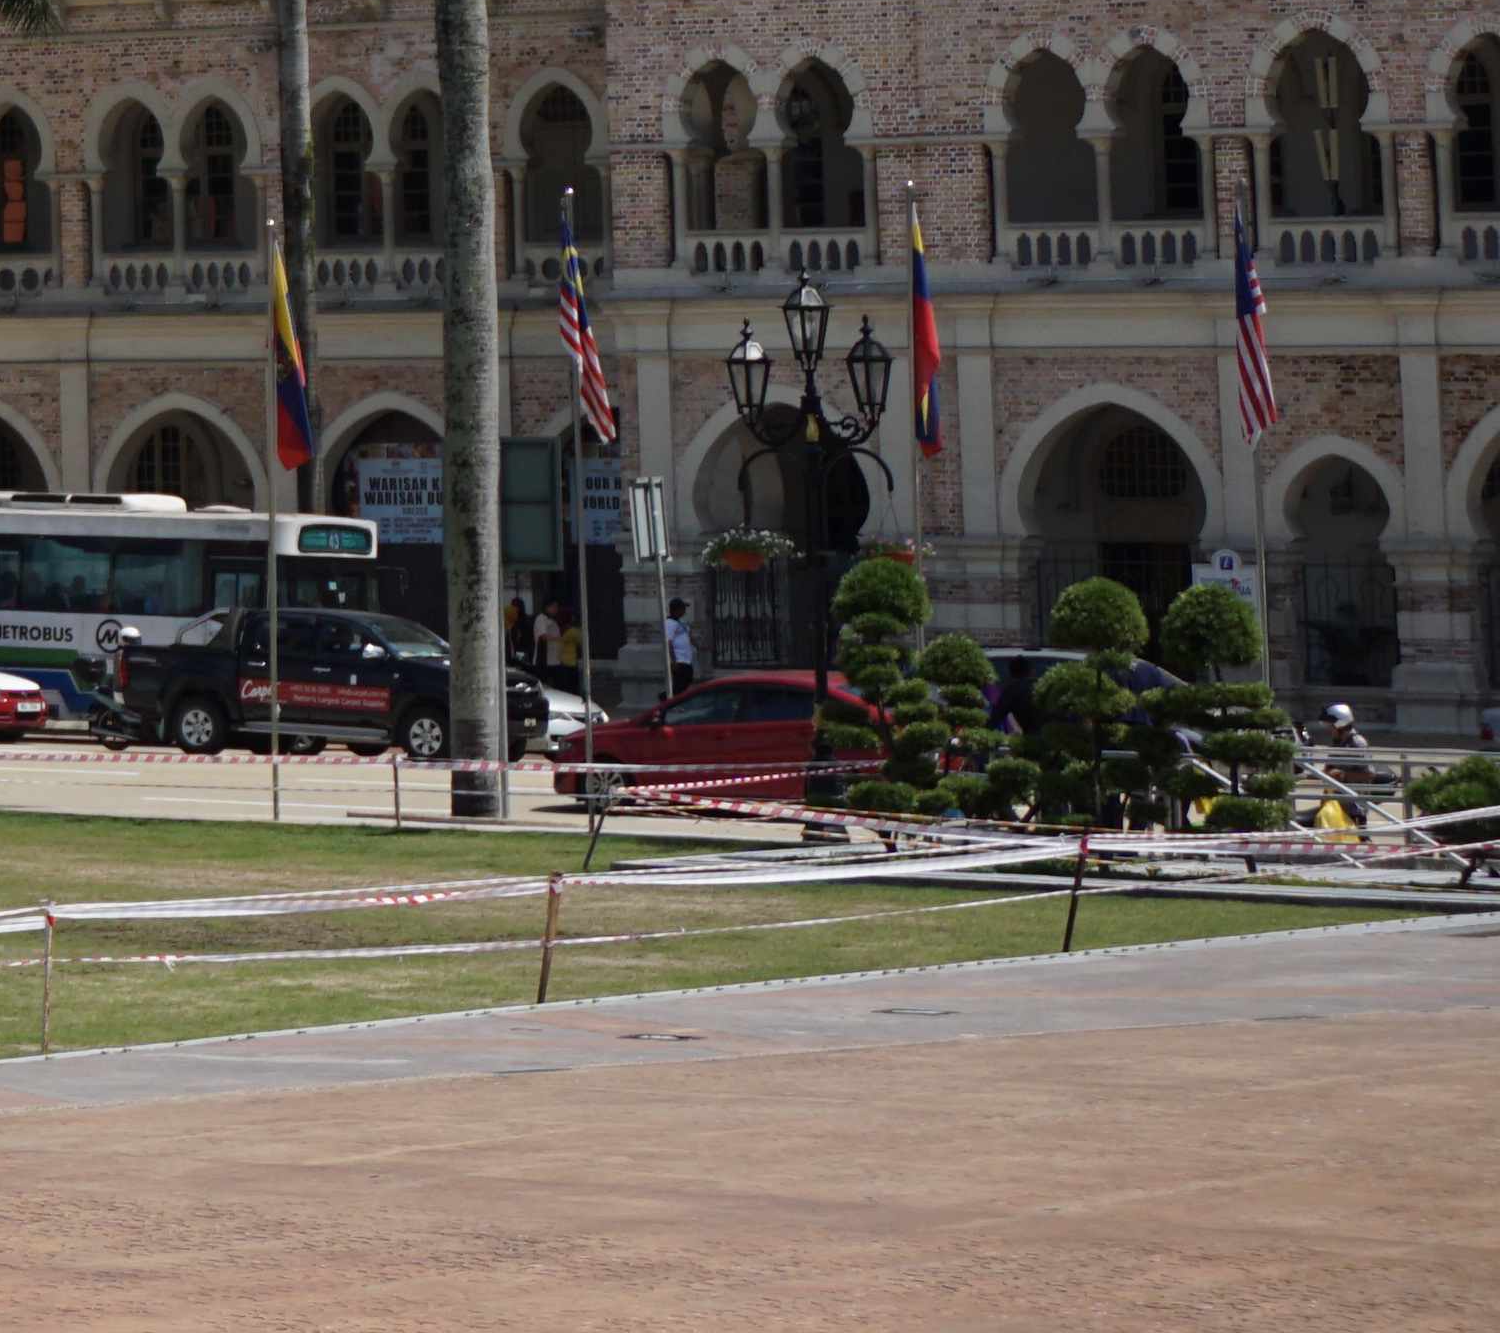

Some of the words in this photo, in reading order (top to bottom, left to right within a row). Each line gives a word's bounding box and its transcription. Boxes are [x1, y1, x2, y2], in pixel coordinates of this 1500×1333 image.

[369, 477, 427, 491] WARISAN
[586, 477, 610, 490] OUR
[364, 492, 422, 505] WARISAN
[329, 533, 340, 550] 43
